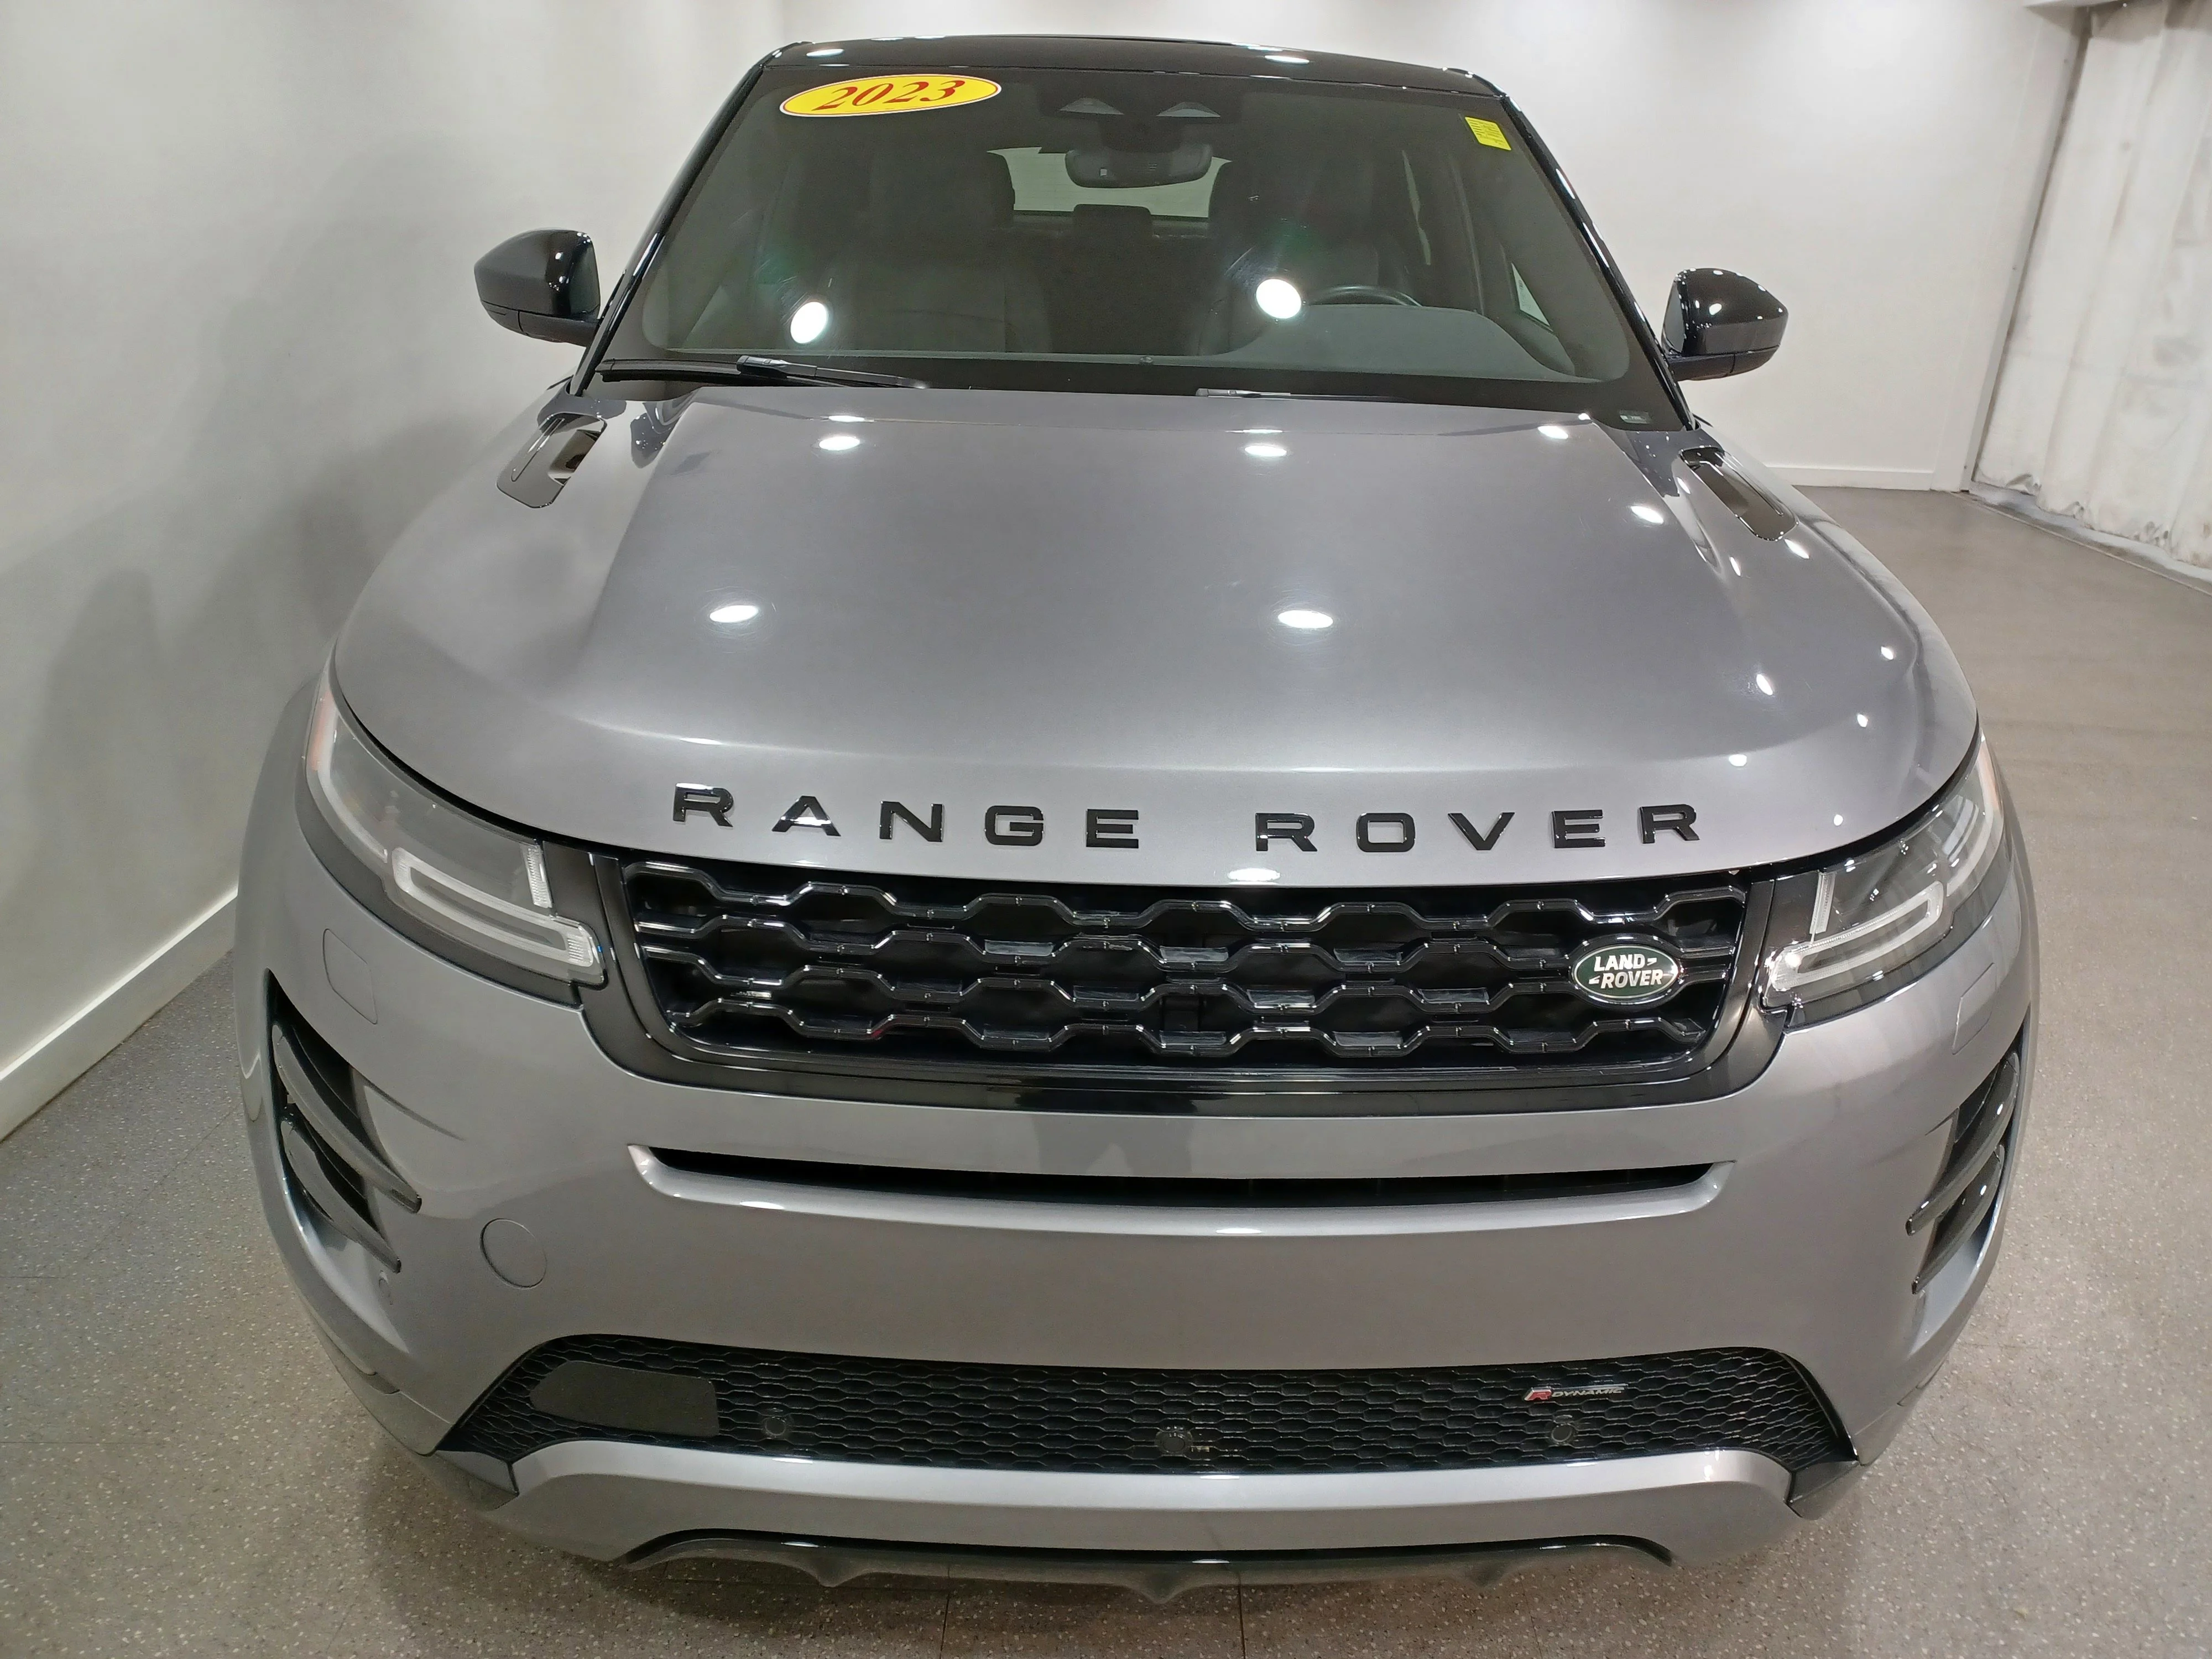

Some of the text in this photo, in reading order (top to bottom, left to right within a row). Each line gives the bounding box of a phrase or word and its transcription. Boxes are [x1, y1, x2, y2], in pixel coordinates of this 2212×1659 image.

[811, 80, 966, 111] 2023
[672, 782, 1700, 853] RANGE ROVER
[1594, 953, 1645, 972] LAND
[1600, 969, 1663, 989] ROVER
